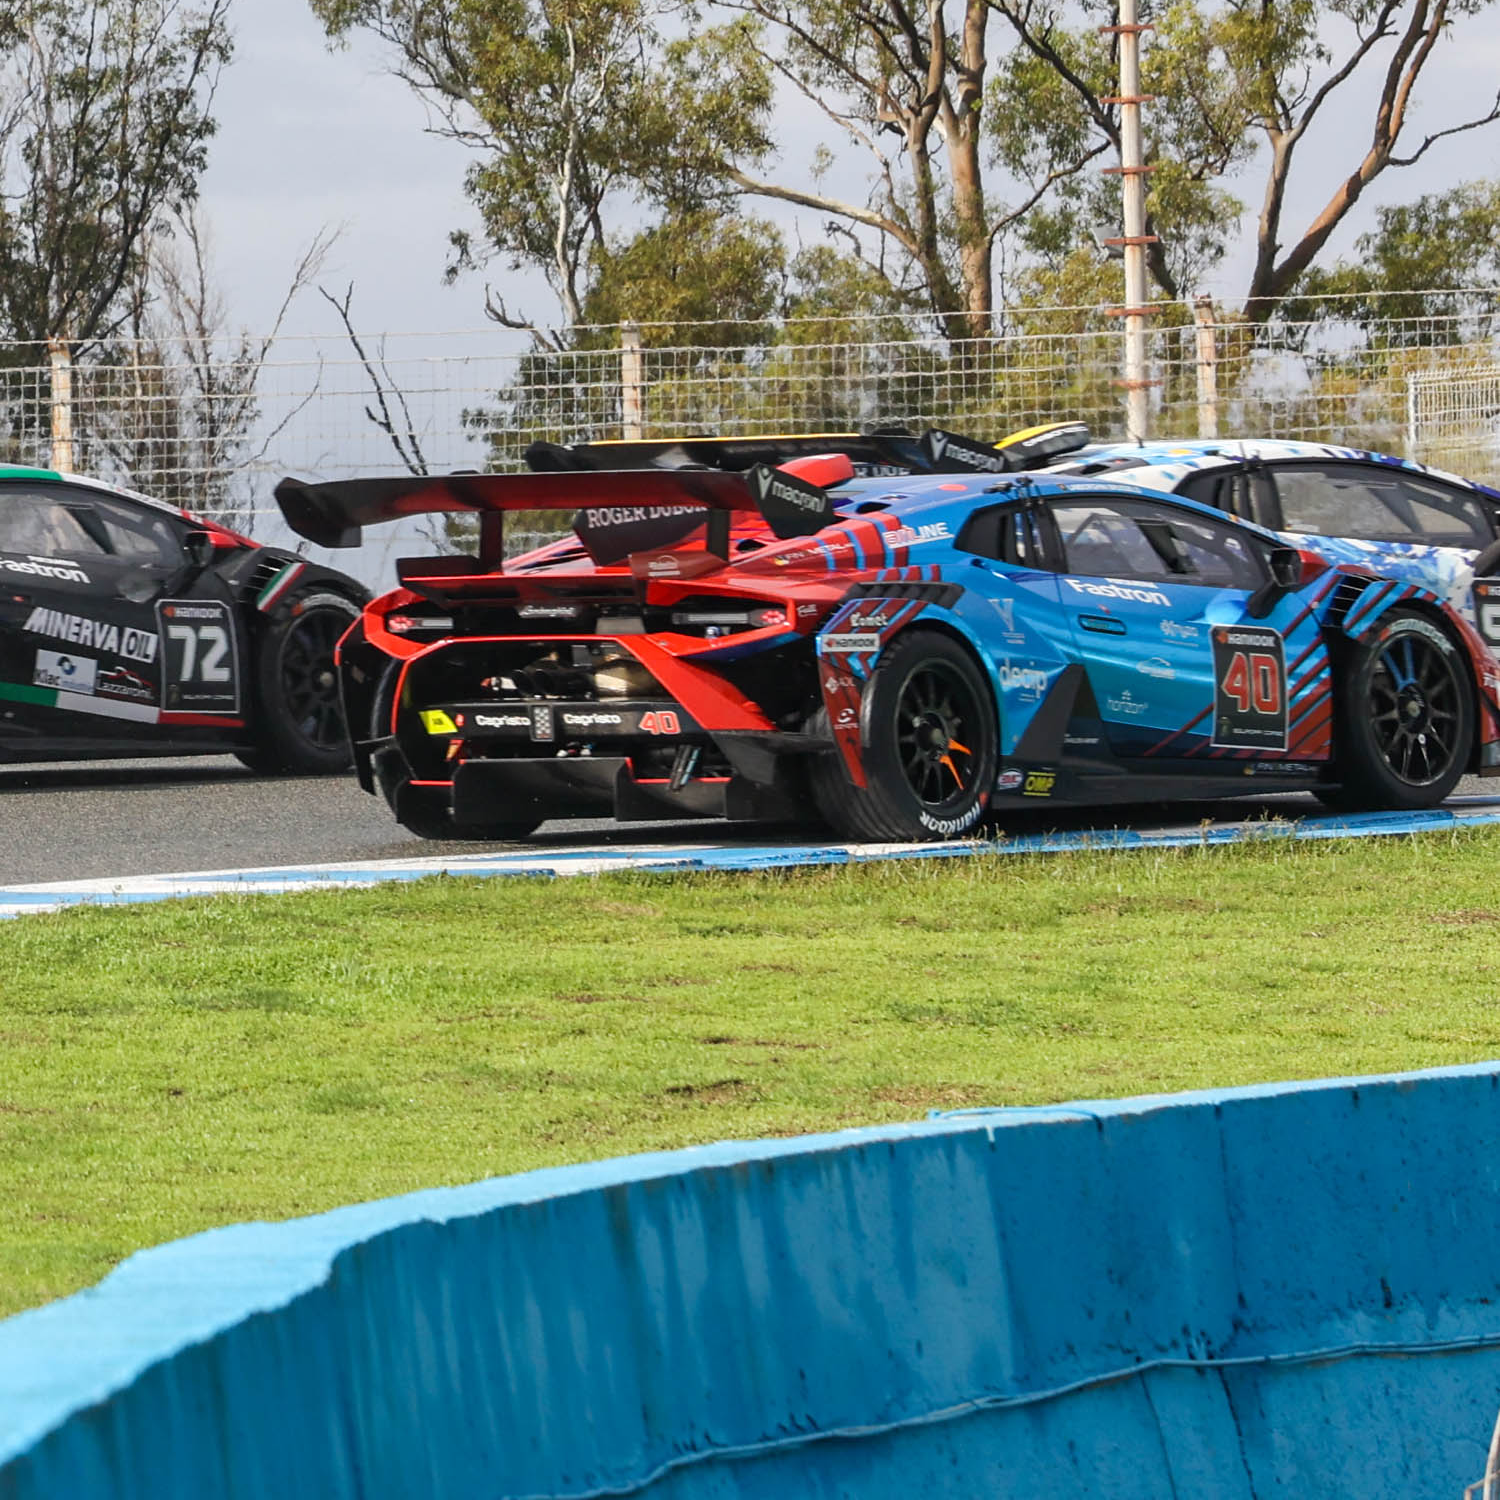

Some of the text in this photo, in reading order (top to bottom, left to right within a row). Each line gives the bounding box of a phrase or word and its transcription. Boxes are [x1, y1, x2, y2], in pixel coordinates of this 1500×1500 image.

[946, 443, 1004, 473] macron
[772, 481, 826, 514] macron
[587, 507, 647, 529] ROGER
[1063, 578, 1172, 607] Fastron
[22, 606, 155, 661] MINERVA OIL
[168, 625, 231, 682] 72
[1220, 651, 1281, 716] 40
[474, 712, 622, 728] Capristo Capristo
[639, 710, 681, 735] 40
[1024, 775, 1054, 792] OMP
